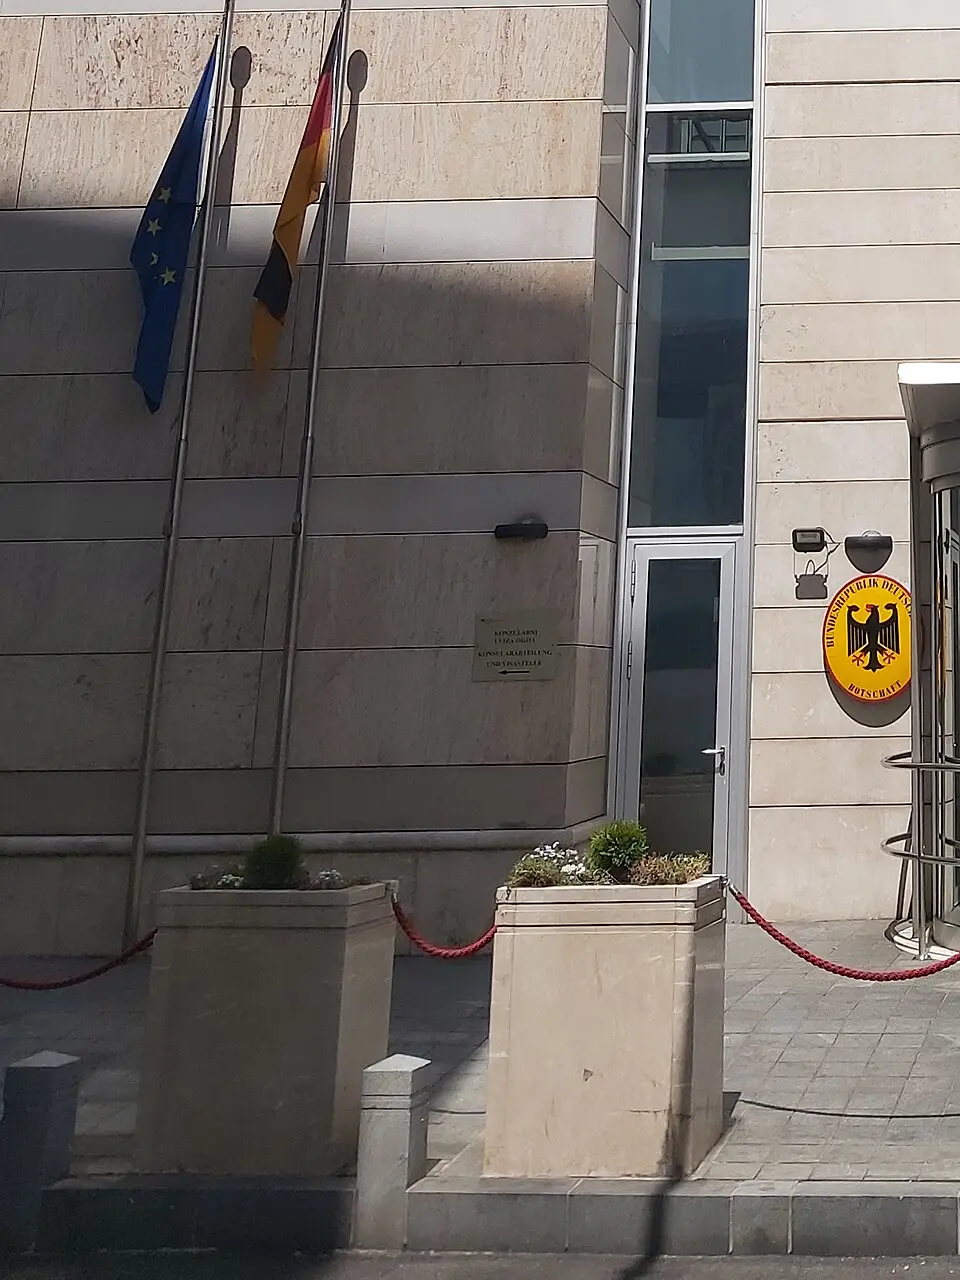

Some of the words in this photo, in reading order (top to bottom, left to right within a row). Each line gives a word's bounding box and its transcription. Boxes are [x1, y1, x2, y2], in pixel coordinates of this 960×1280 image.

[826, 578, 880, 648] BUNDESREPUBLIK
[881, 580, 912, 618] DEUTSC
[847, 679, 903, 699] BOTSCHAFT
